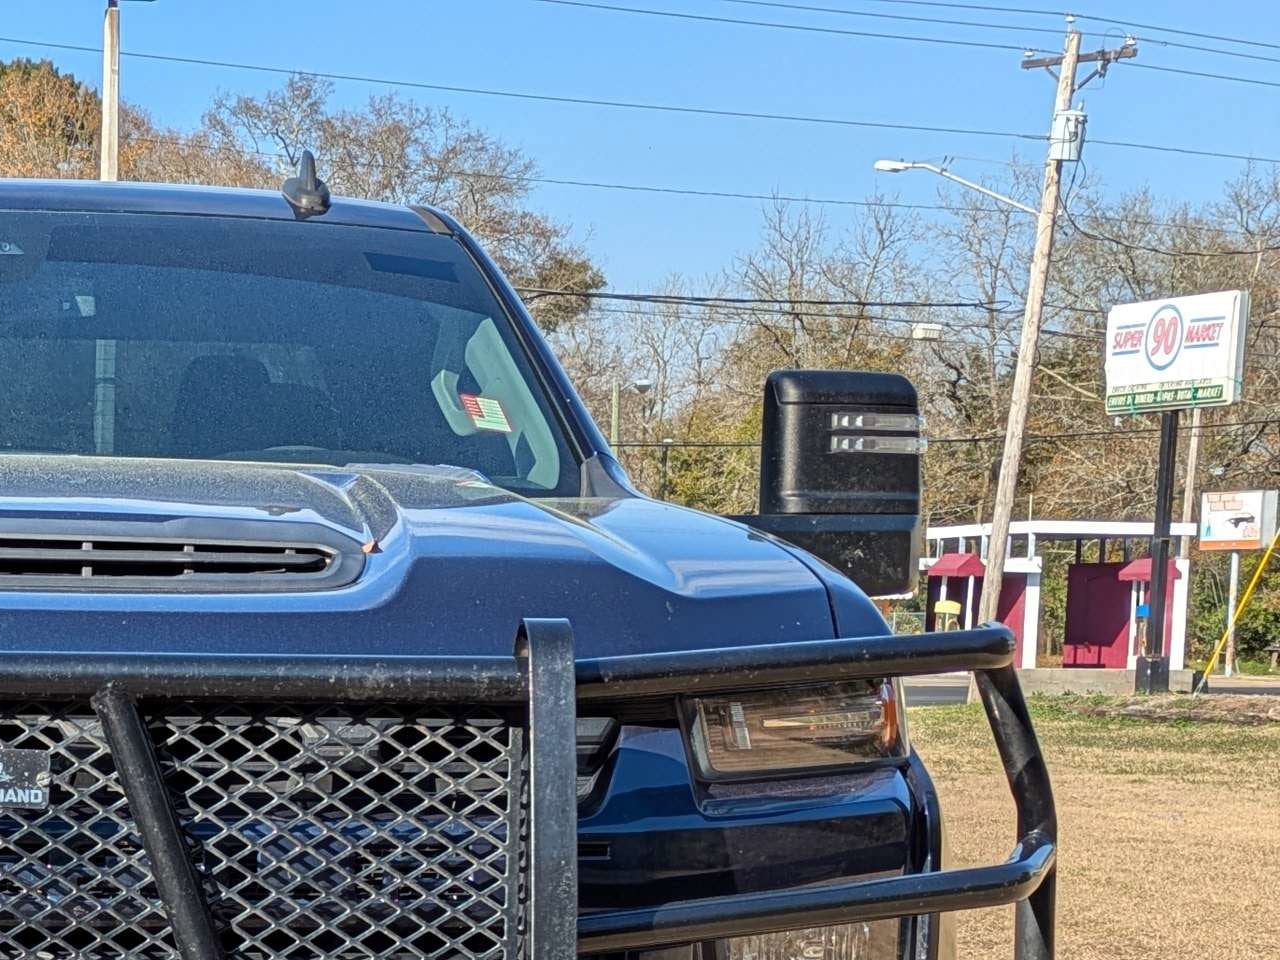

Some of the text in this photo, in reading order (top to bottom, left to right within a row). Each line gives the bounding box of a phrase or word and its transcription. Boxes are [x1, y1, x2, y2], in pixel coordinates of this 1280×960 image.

[1113, 316, 1224, 356] SUPER 90 MARKET
